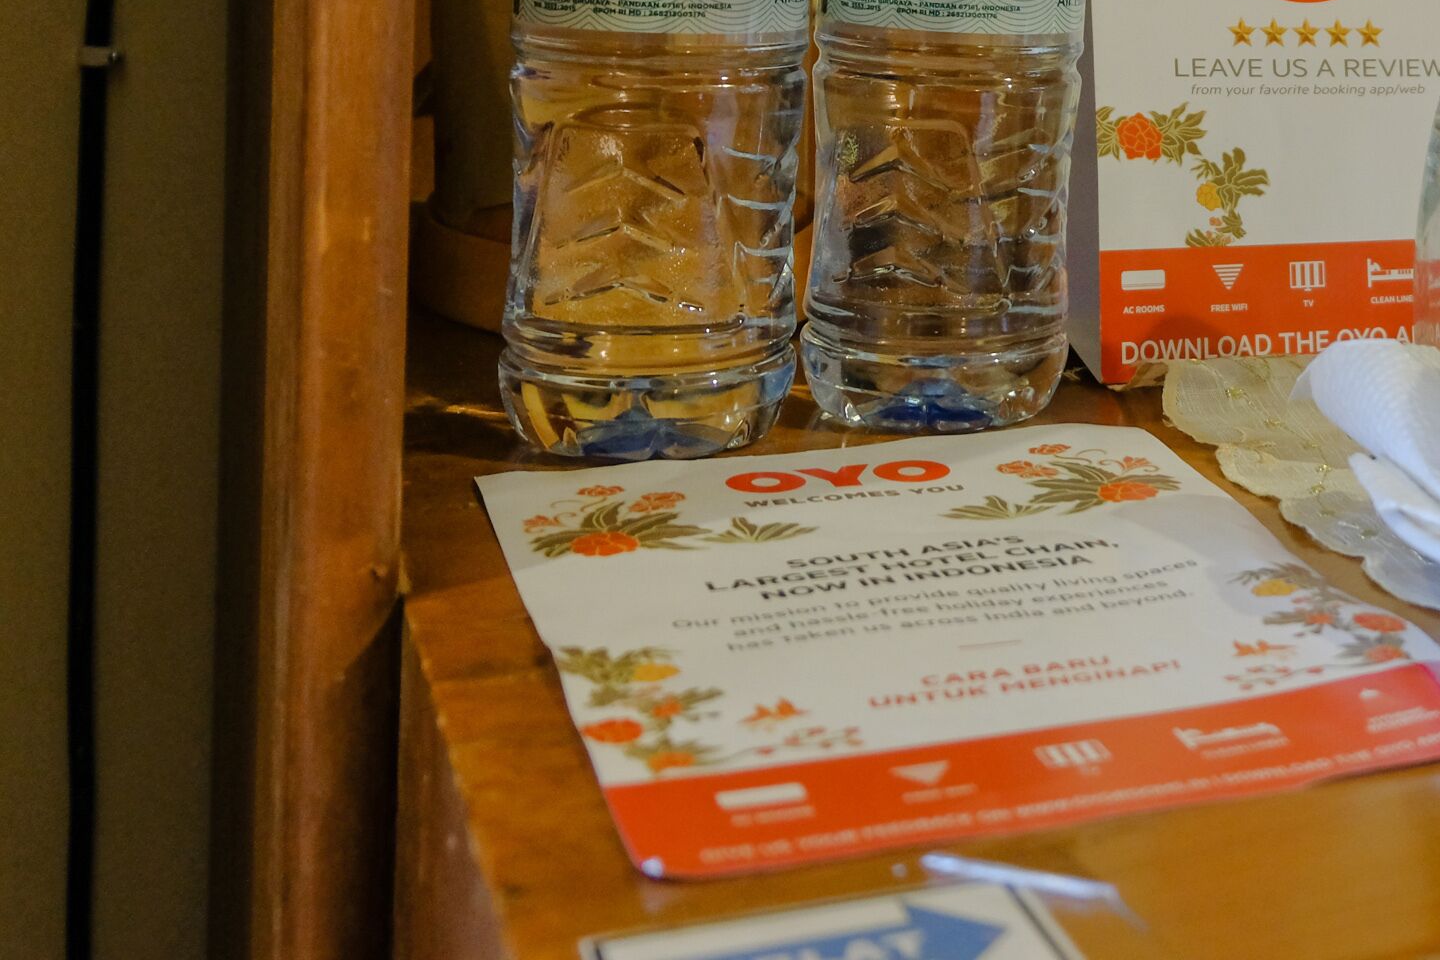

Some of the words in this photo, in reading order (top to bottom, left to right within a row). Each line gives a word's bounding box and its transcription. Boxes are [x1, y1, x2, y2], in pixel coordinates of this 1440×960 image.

[688, 1, 733, 10] INDONESIA
[981, 4, 1021, 13] INDONESIA
[1174, 58, 1263, 78] LEAVE
[1272, 58, 1308, 78] US
[1316, 58, 1336, 78] A
[1191, 83, 1222, 96] from
[1225, 86, 1254, 98] your
[1259, 83, 1309, 96] favorite
[1313, 83, 1366, 98] booking
[1369, 84, 1425, 98] app/web
[1122, 305, 1135, 315] AC
[1135, 304, 1166, 314] ROOMS
[1210, 303, 1230, 313] FREE
[1302, 298, 1315, 308] TV
[1370, 295, 1396, 305] CLEAN
[1121, 333, 1273, 365] DOWNLOAD
[1278, 330, 1330, 354] THE
[725, 459, 952, 494] OYO
[744, 489, 901, 509] WELCOMES
[907, 484, 966, 496] YOU
[786, 547, 911, 569] SOUTH
[920, 534, 1025, 555] ASIA'S
[704, 564, 870, 592] LARGEST
[881, 550, 1000, 572] HOTEL
[1004, 538, 1120, 557] CHAIN,
[760, 580, 848, 600] NOW
[857, 574, 896, 588] IN
[903, 554, 1094, 582] INDONESIA
[671, 617, 720, 630] Our
[730, 603, 827, 626] mission
[833, 598, 861, 610] to
[867, 589, 960, 608] provide
[967, 580, 1048, 600] quality
[1052, 574, 1118, 589] living
[1122, 559, 1198, 580] spaces
[733, 623, 782, 638] and
[788, 604, 930, 631] hassle-free
[936, 596, 1024, 613] holiday
[1031, 579, 1169, 604] experiences
[727, 639, 775, 652] has
[782, 625, 856, 645] taken
[862, 622, 893, 633] us
[900, 614, 979, 629] across
[984, 607, 1045, 622] India
[1051, 601, 1096, 616] and
[920, 667, 1012, 688] CARA
[1022, 655, 1111, 678] BARU
[867, 684, 988, 709] UNTUK
